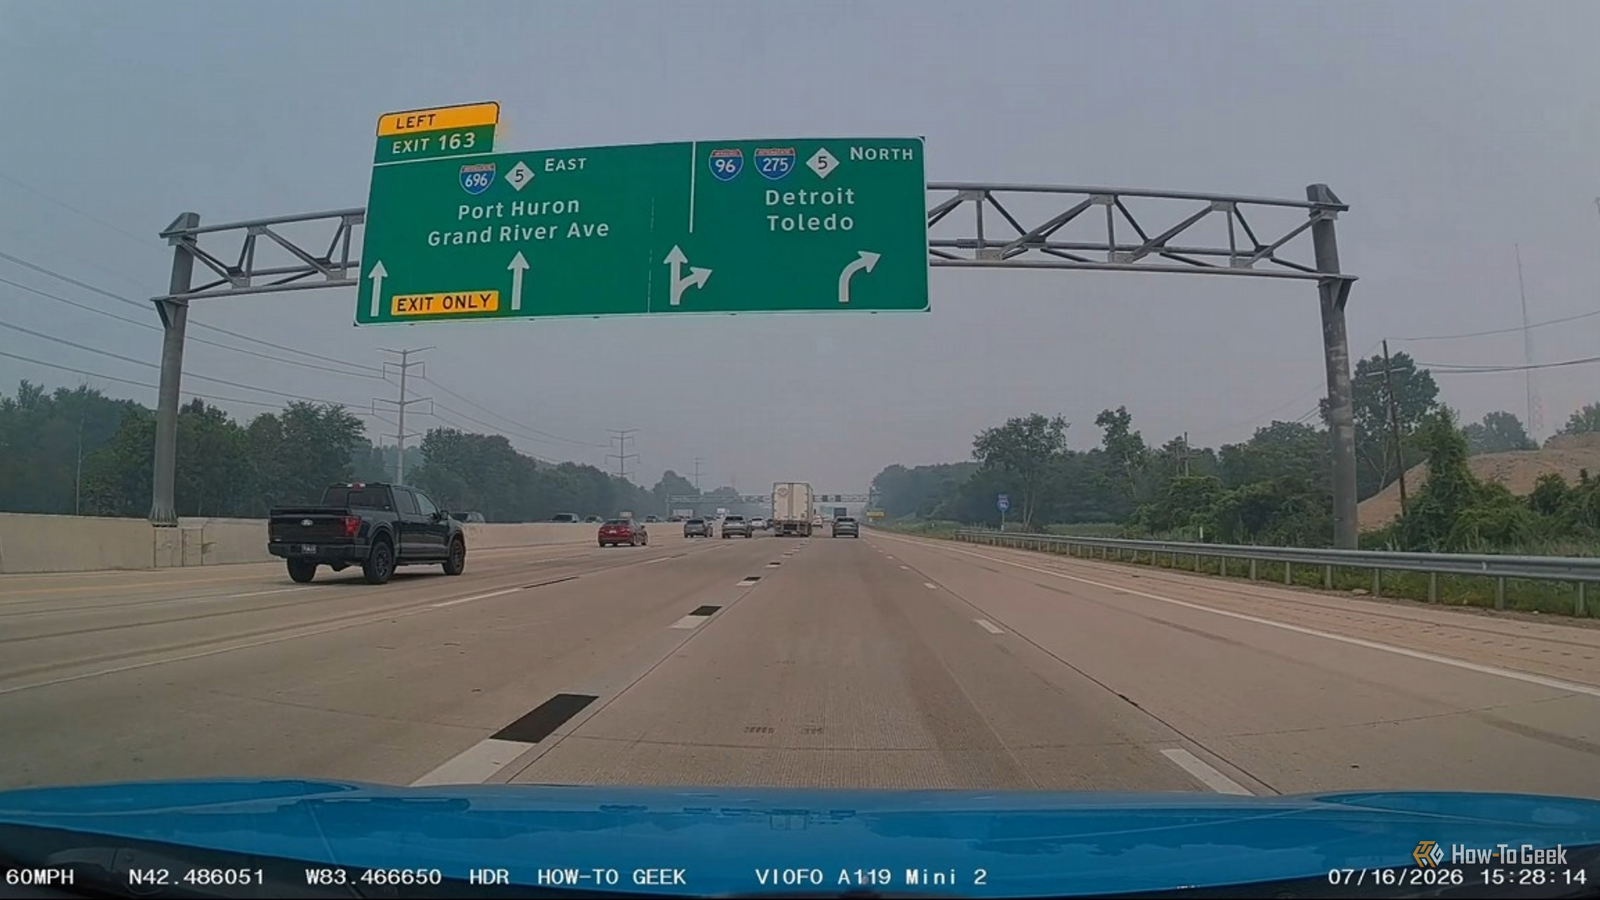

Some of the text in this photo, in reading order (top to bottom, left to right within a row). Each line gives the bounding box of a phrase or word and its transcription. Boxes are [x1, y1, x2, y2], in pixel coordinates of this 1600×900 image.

[396, 114, 436, 129] LEFT
[392, 132, 476, 154] EXIT 163
[850, 146, 913, 161] NORTH
[544, 158, 587, 172] EAST
[715, 158, 736, 174] 96
[762, 157, 789, 172] 275
[817, 155, 828, 170] 5
[464, 172, 488, 188] 696
[514, 169, 525, 183] 5
[765, 187, 855, 206] Detroit
[458, 199, 580, 220] Port Huron
[767, 213, 854, 231] Toledo
[428, 222, 610, 247] Grand River Ave
[397, 293, 491, 312] EXIT ONLY
